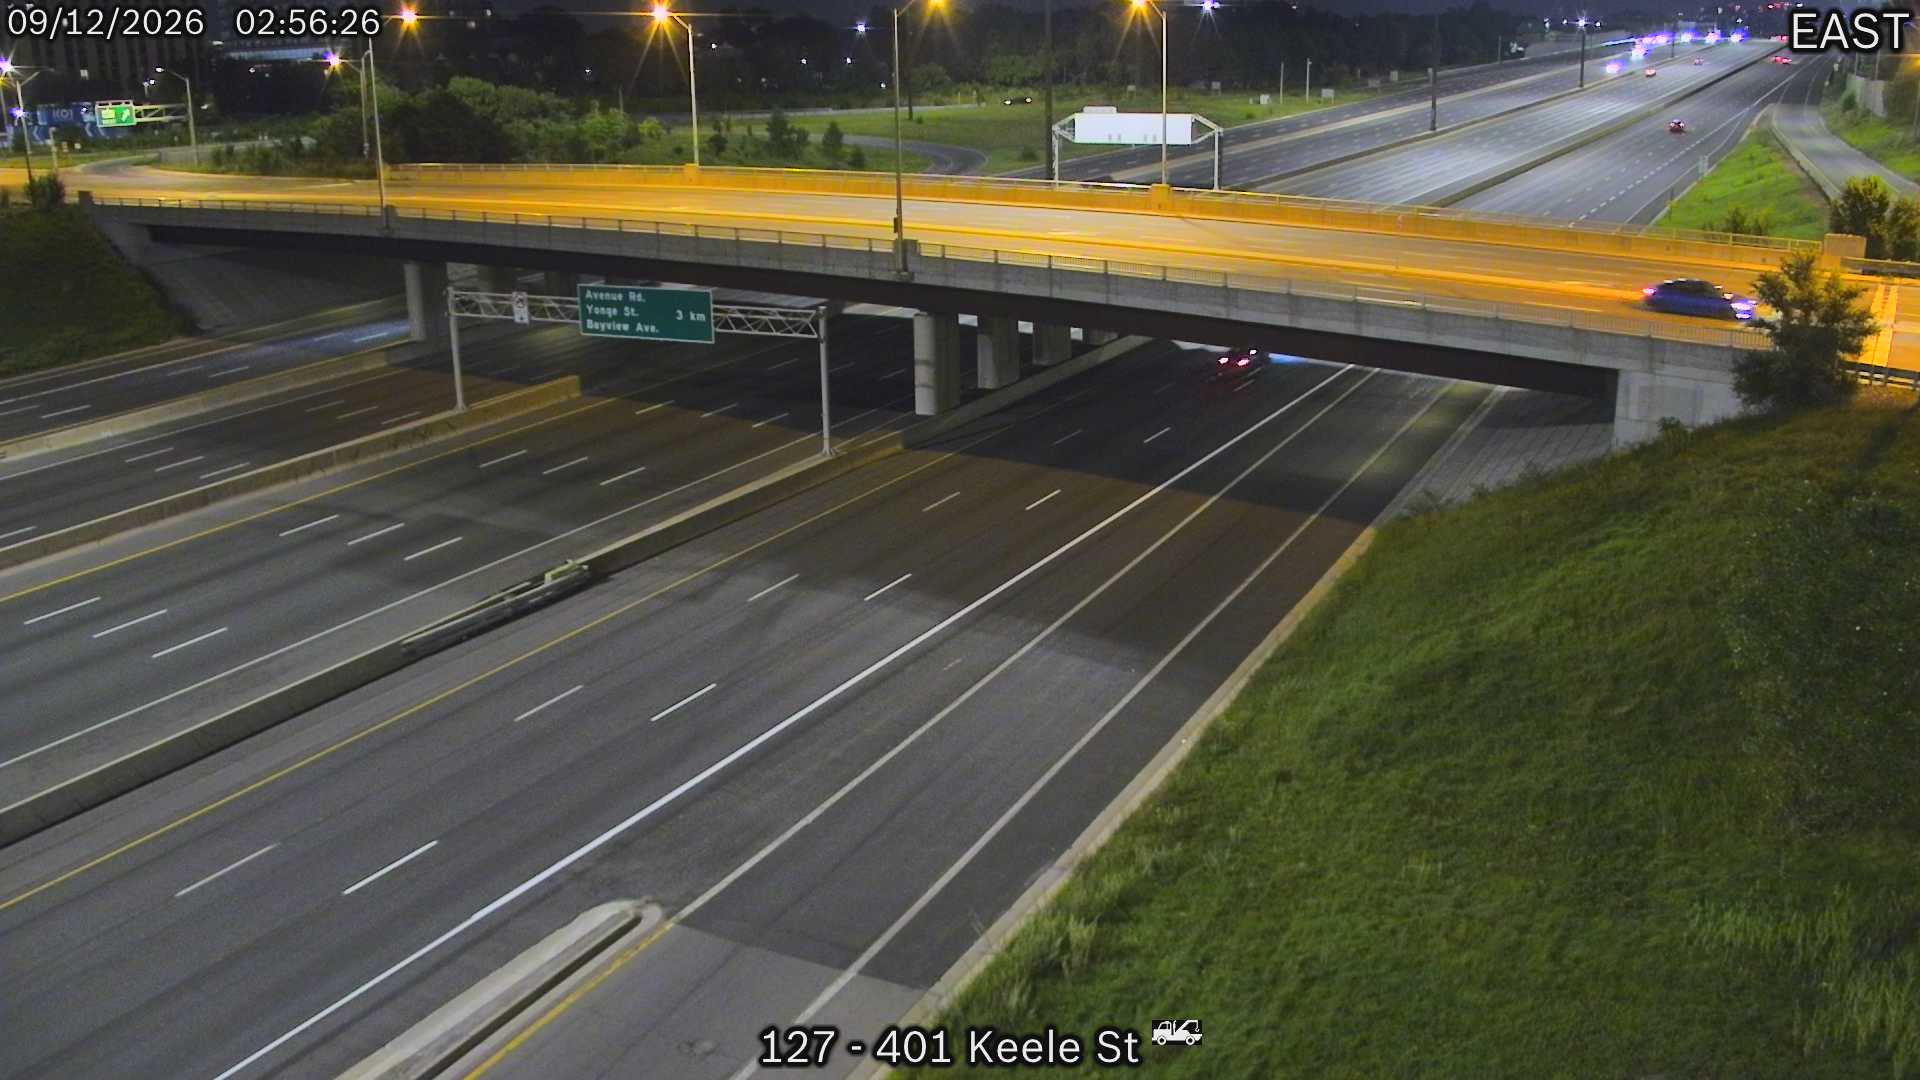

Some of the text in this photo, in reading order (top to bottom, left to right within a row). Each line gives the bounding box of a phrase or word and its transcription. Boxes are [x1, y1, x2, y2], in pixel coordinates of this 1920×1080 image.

[585, 290, 646, 303] Avenue Rd.
[586, 304, 640, 318] Yonge St.
[675, 310, 706, 322] 3 km
[586, 319, 660, 333] Bayview Ave.
